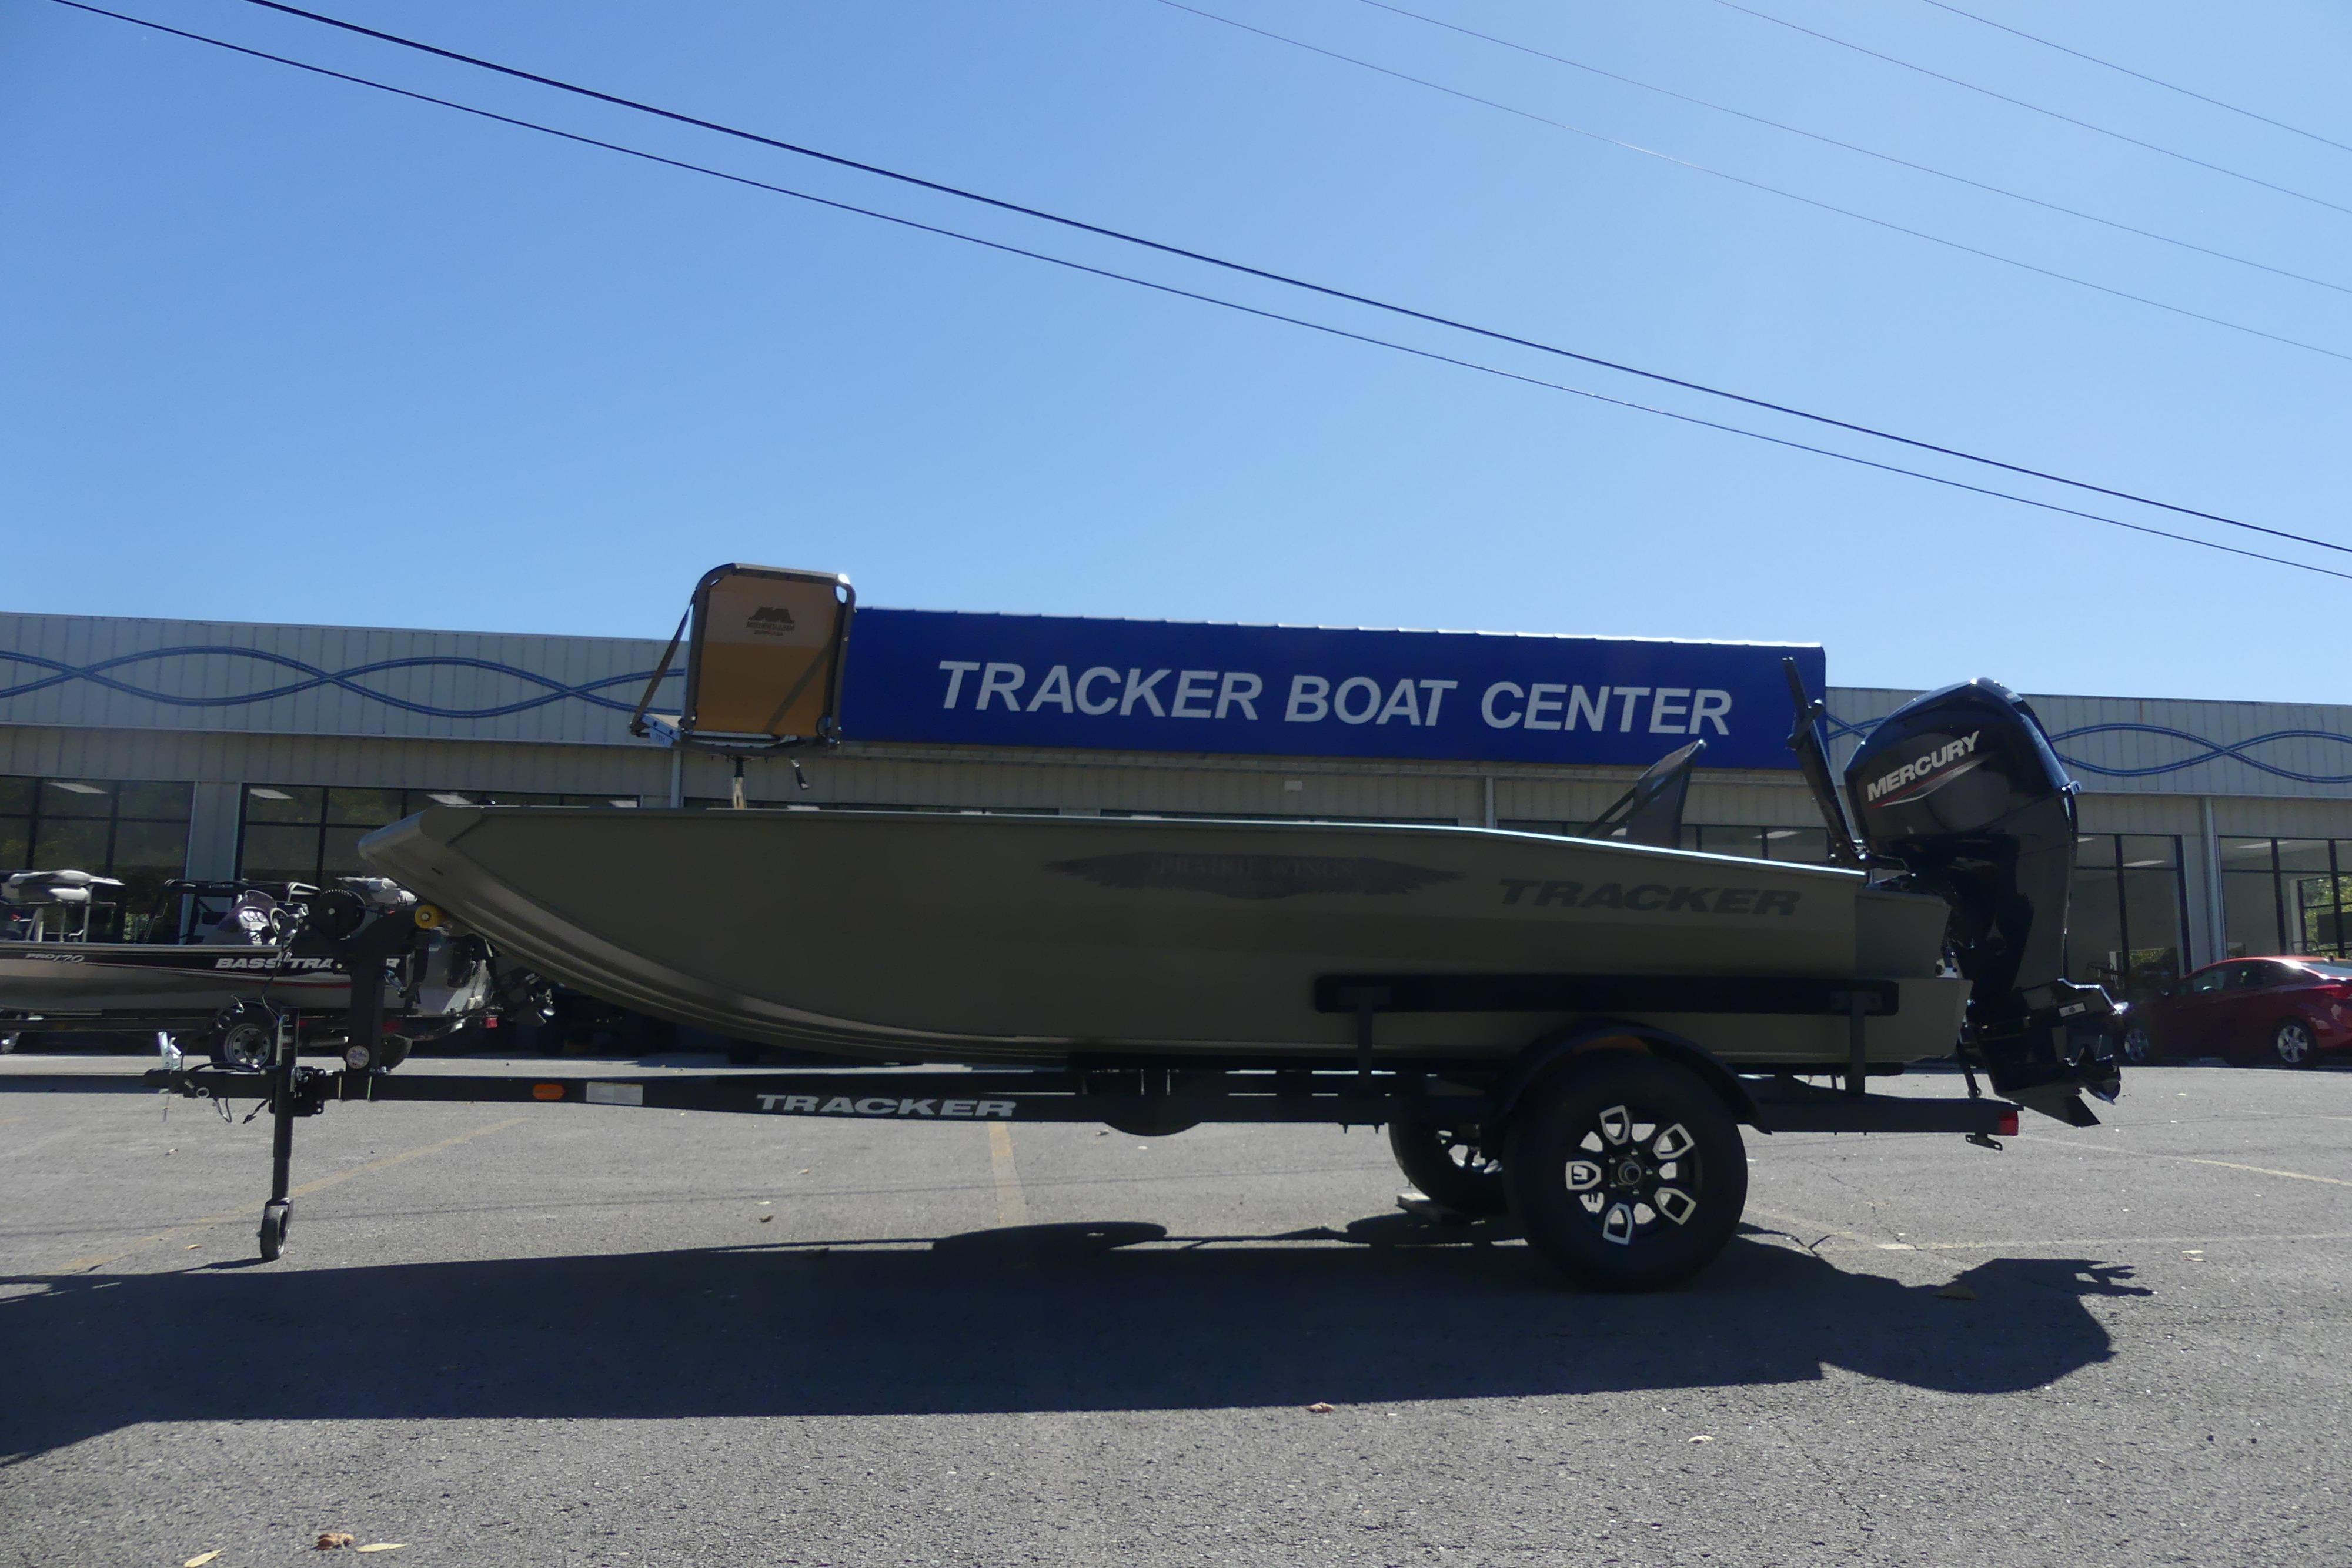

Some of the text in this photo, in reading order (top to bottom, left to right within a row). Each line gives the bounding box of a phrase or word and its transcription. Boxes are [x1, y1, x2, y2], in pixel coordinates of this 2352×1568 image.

[937, 658, 1732, 737] TRACKER BOAT CENTER
[1867, 730, 1980, 802] MERCURY
[1499, 878, 1801, 917] TRACKER
[215, 958, 400, 969] BASS TRAR
[756, 1094, 1017, 1117] TRACKER
